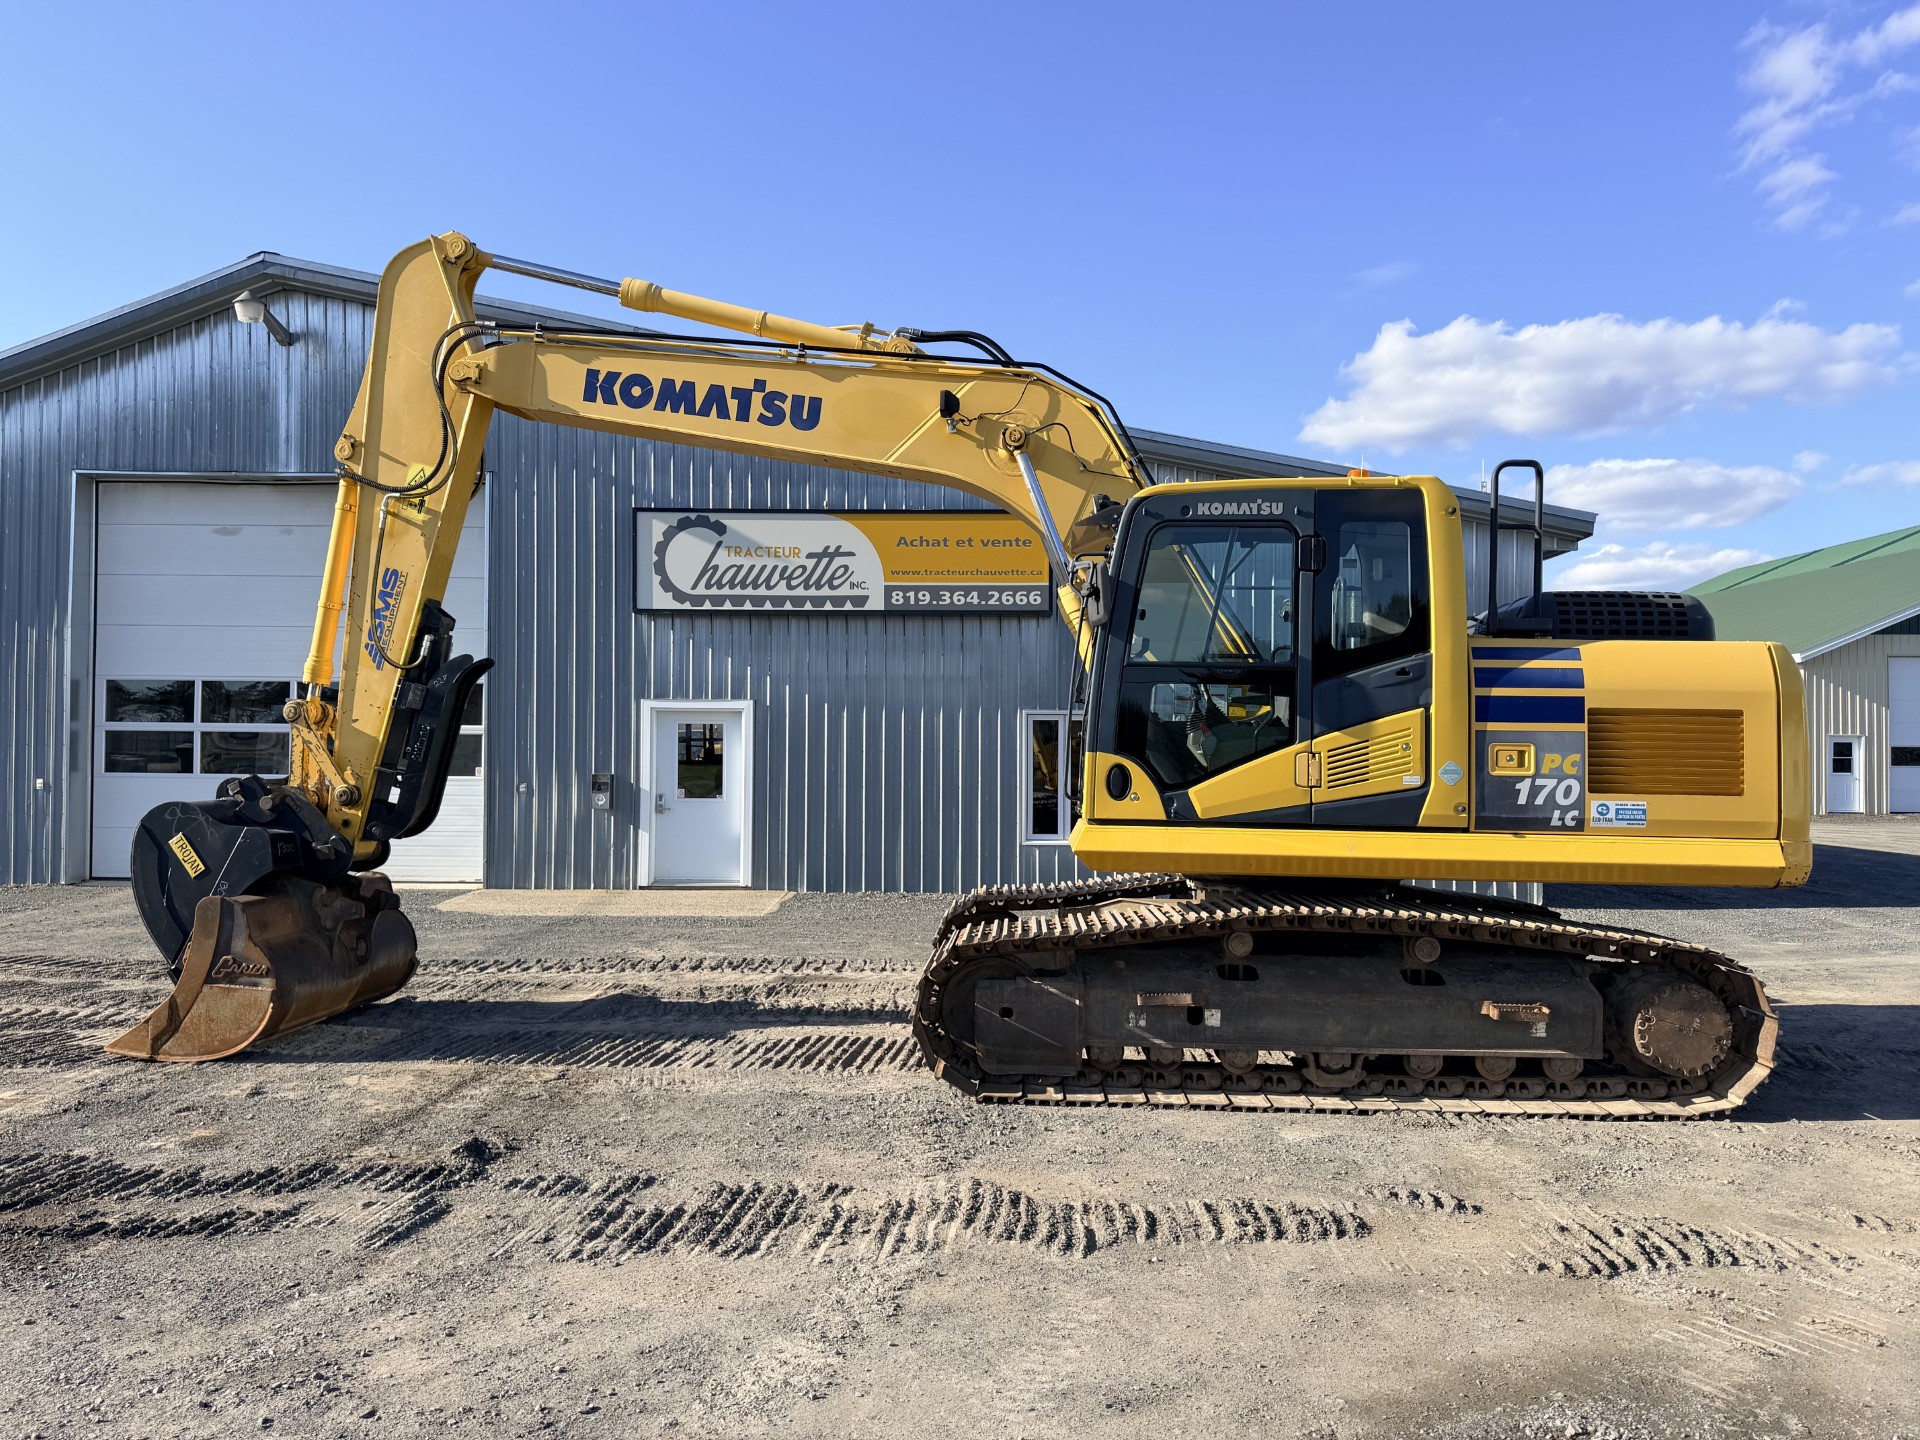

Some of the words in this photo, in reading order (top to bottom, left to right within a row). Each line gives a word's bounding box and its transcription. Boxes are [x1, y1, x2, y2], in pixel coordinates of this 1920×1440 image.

[582, 367, 823, 432] KOMATSU
[1197, 498, 1284, 516] KOMATSU
[896, 536, 950, 548] Achat
[955, 537, 975, 548] et
[980, 537, 1033, 548] vente
[724, 545, 802, 559] TRACTEUR
[890, 568, 1043, 577] www.tracteurchauvette.ca
[849, 580, 870, 591] INC.
[367, 567, 400, 643] SMS
[890, 590, 1042, 605] 819.364.2666
[381, 570, 406, 646] EQUIPMENT
[1540, 753, 1581, 775] PC
[1514, 777, 1581, 806] 170
[1549, 809, 1580, 827] LC
[173, 837, 203, 876] TROJAN
